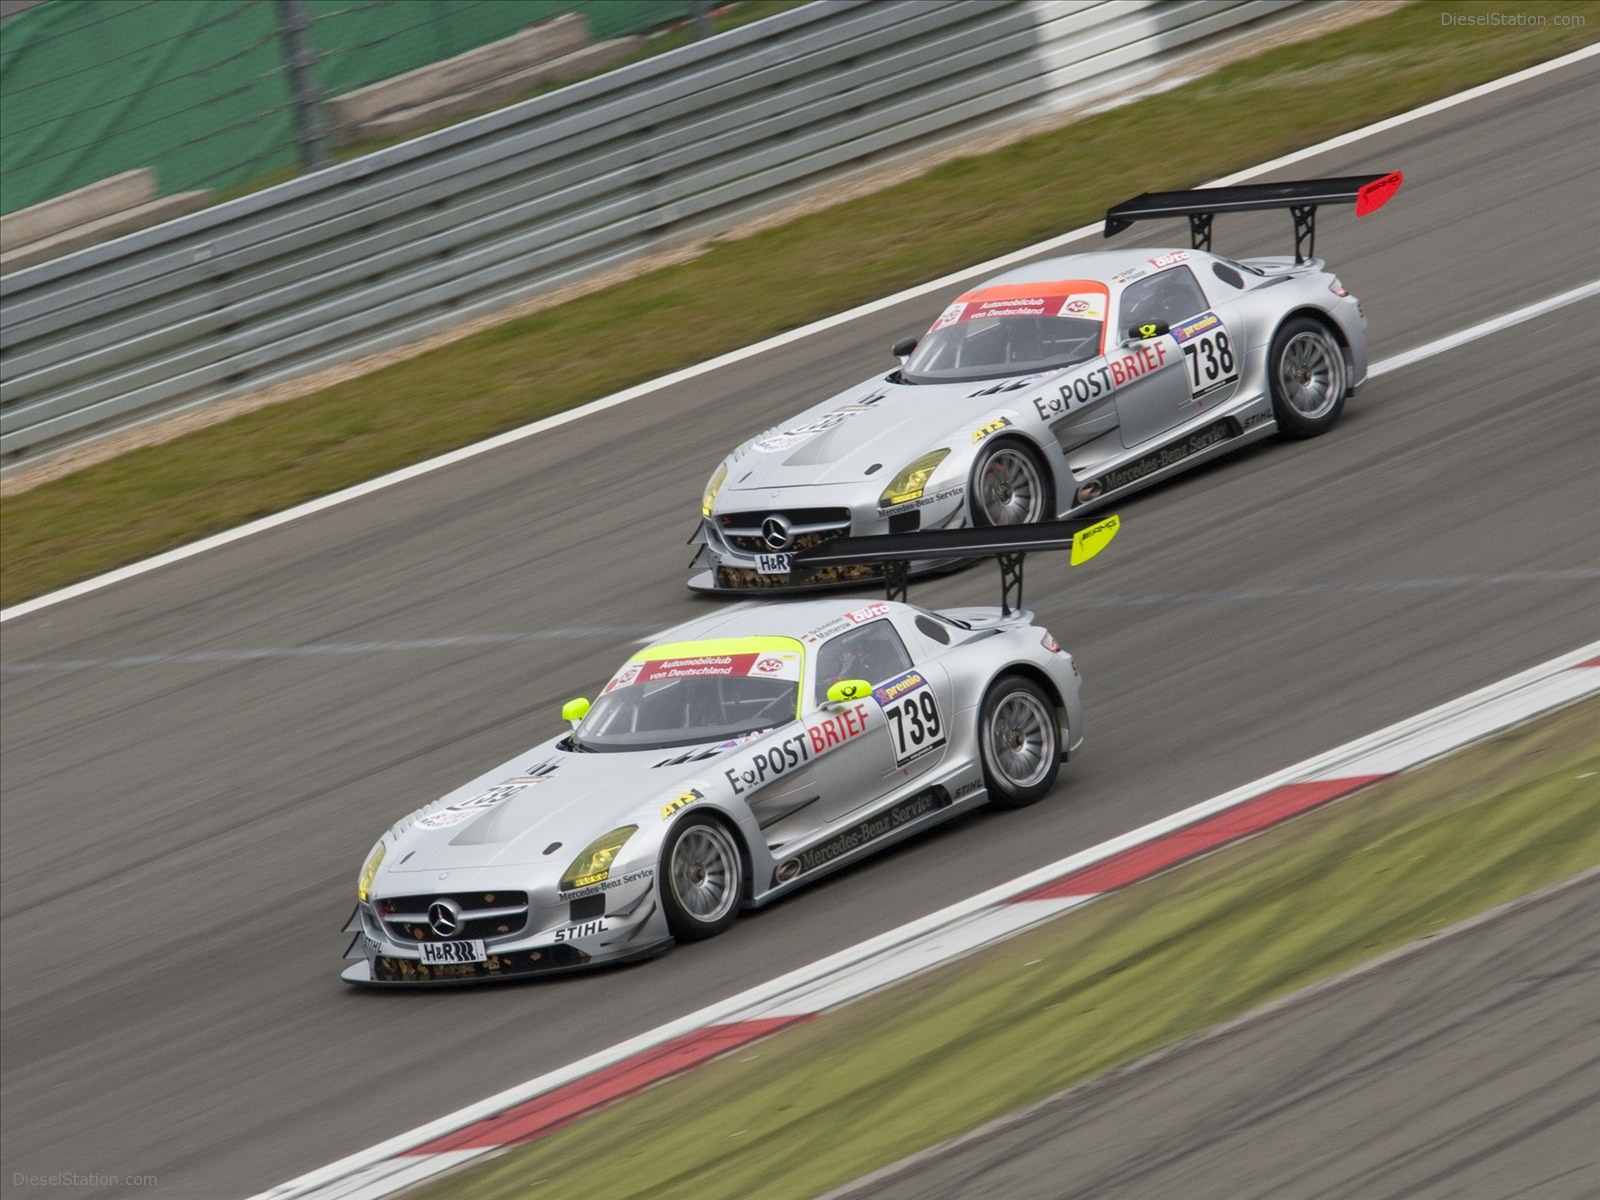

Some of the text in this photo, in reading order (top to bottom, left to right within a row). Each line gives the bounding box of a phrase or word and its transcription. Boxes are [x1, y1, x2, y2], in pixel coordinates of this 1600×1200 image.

[980, 298, 1044, 309] Automobilclub
[986, 307, 1044, 317] Deutschland
[1183, 331, 1233, 387] 738
[1244, 409, 1273, 428] STIHL
[1105, 423, 1228, 491] Mercedes-Benz Service
[878, 487, 964, 518] Mercedes-Benz Service
[760, 554, 788, 571] H&R
[659, 656, 733, 669] Automobilclub
[650, 667, 733, 680] von Deutschland
[886, 673, 922, 699] premio
[886, 691, 941, 753] 739
[955, 779, 983, 798] STIHL
[802, 793, 932, 870] Mercedes-Benz Service
[559, 869, 654, 902] Mercedes-Benz Service
[555, 920, 609, 943] STIHL
[423, 942, 455, 961] H&R
